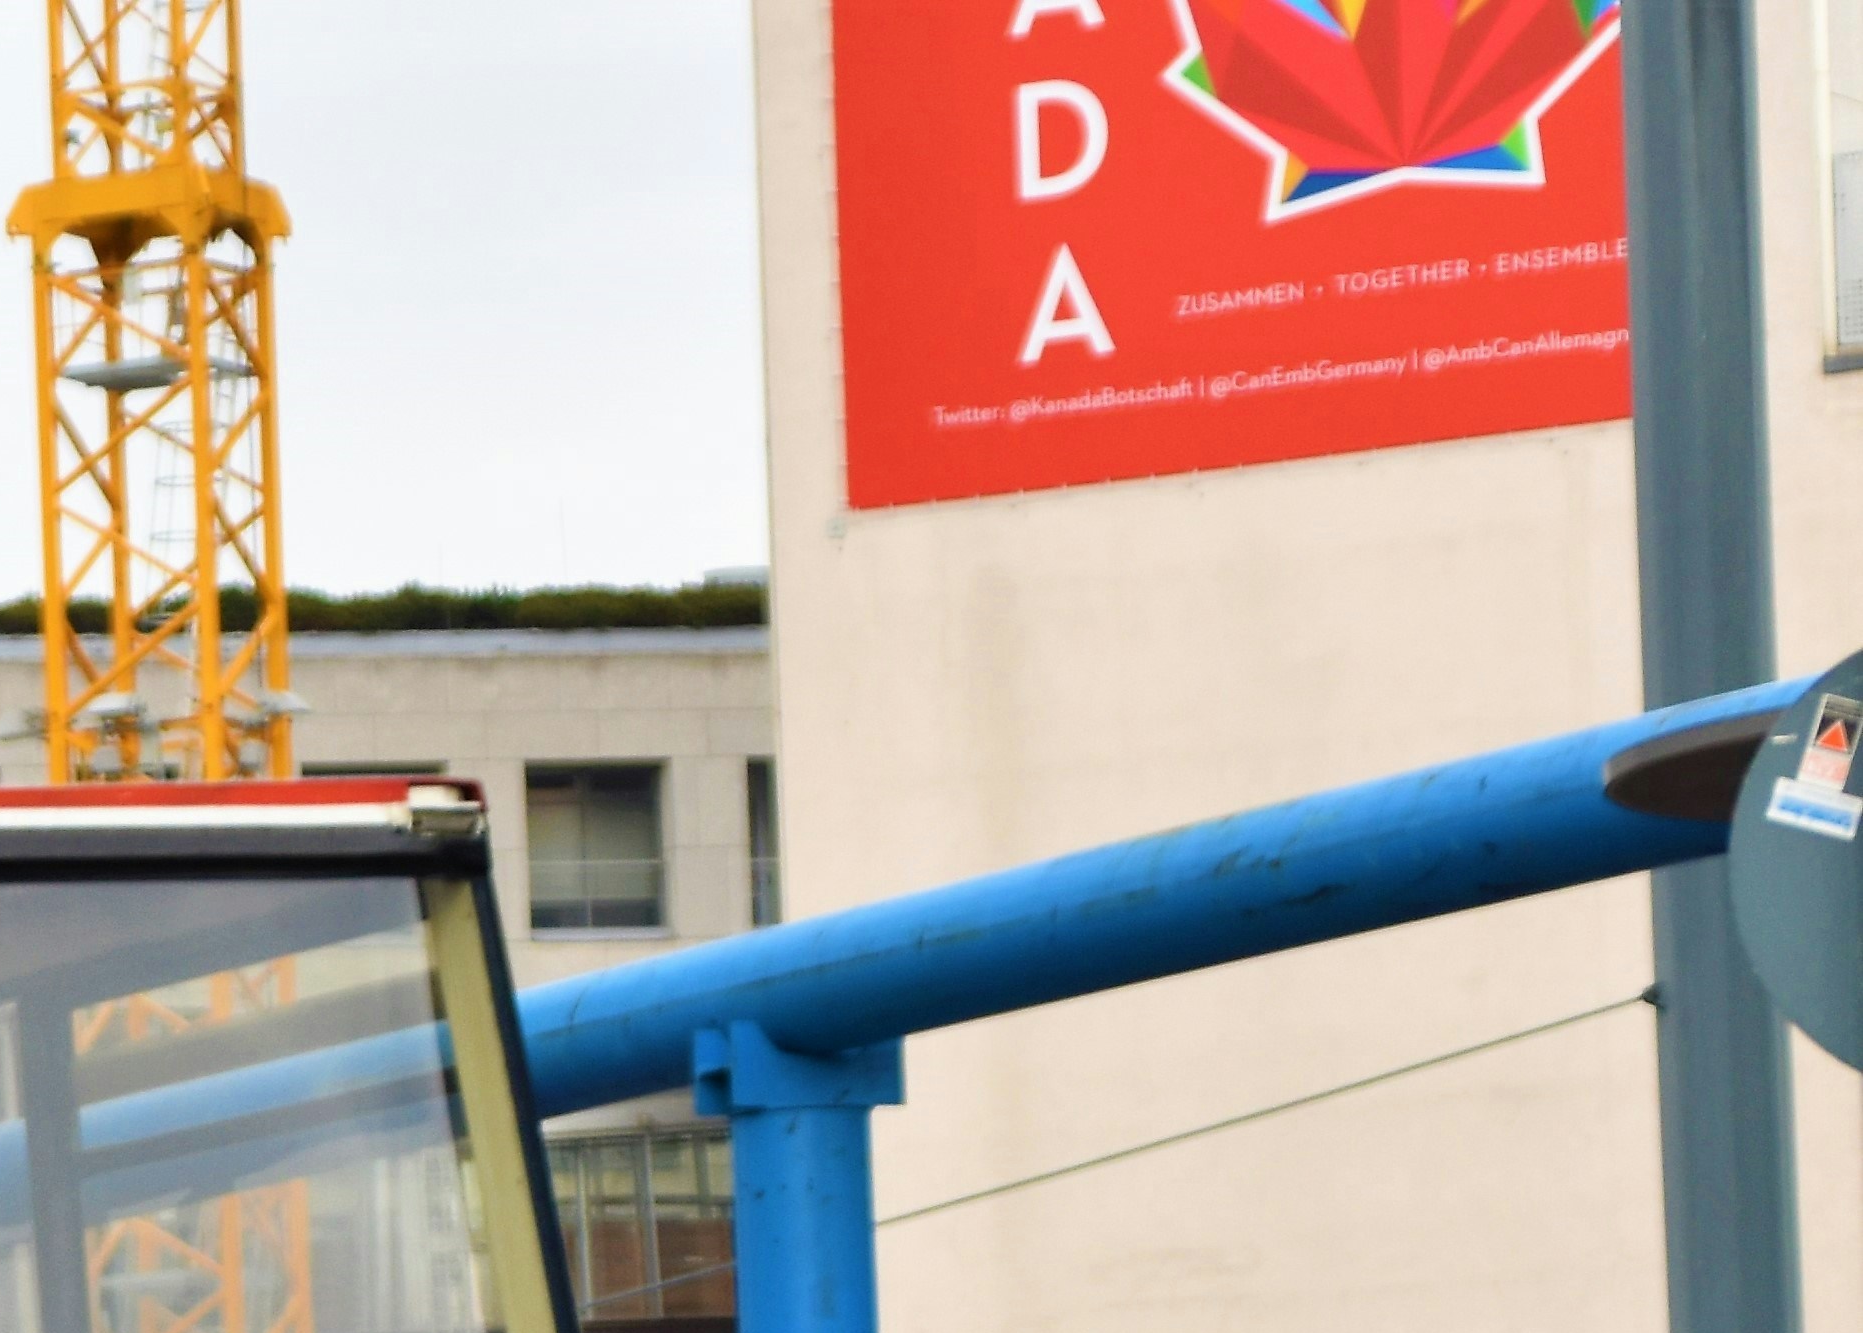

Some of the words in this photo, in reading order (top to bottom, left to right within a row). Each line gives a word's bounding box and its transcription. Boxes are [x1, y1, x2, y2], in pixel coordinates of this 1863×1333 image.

[1176, 281, 1304, 316] ZUSAMMEN
[1334, 257, 1471, 294] TOGETHER
[1495, 237, 1629, 275] ENSEMBLE
[933, 404, 1005, 427] Twitter:
[1009, 376, 1193, 423] @KanadaBotschaft
[1209, 355, 1406, 399] @CanEmbGermany
[1424, 327, 1630, 370] @AmbCanAllemagn
